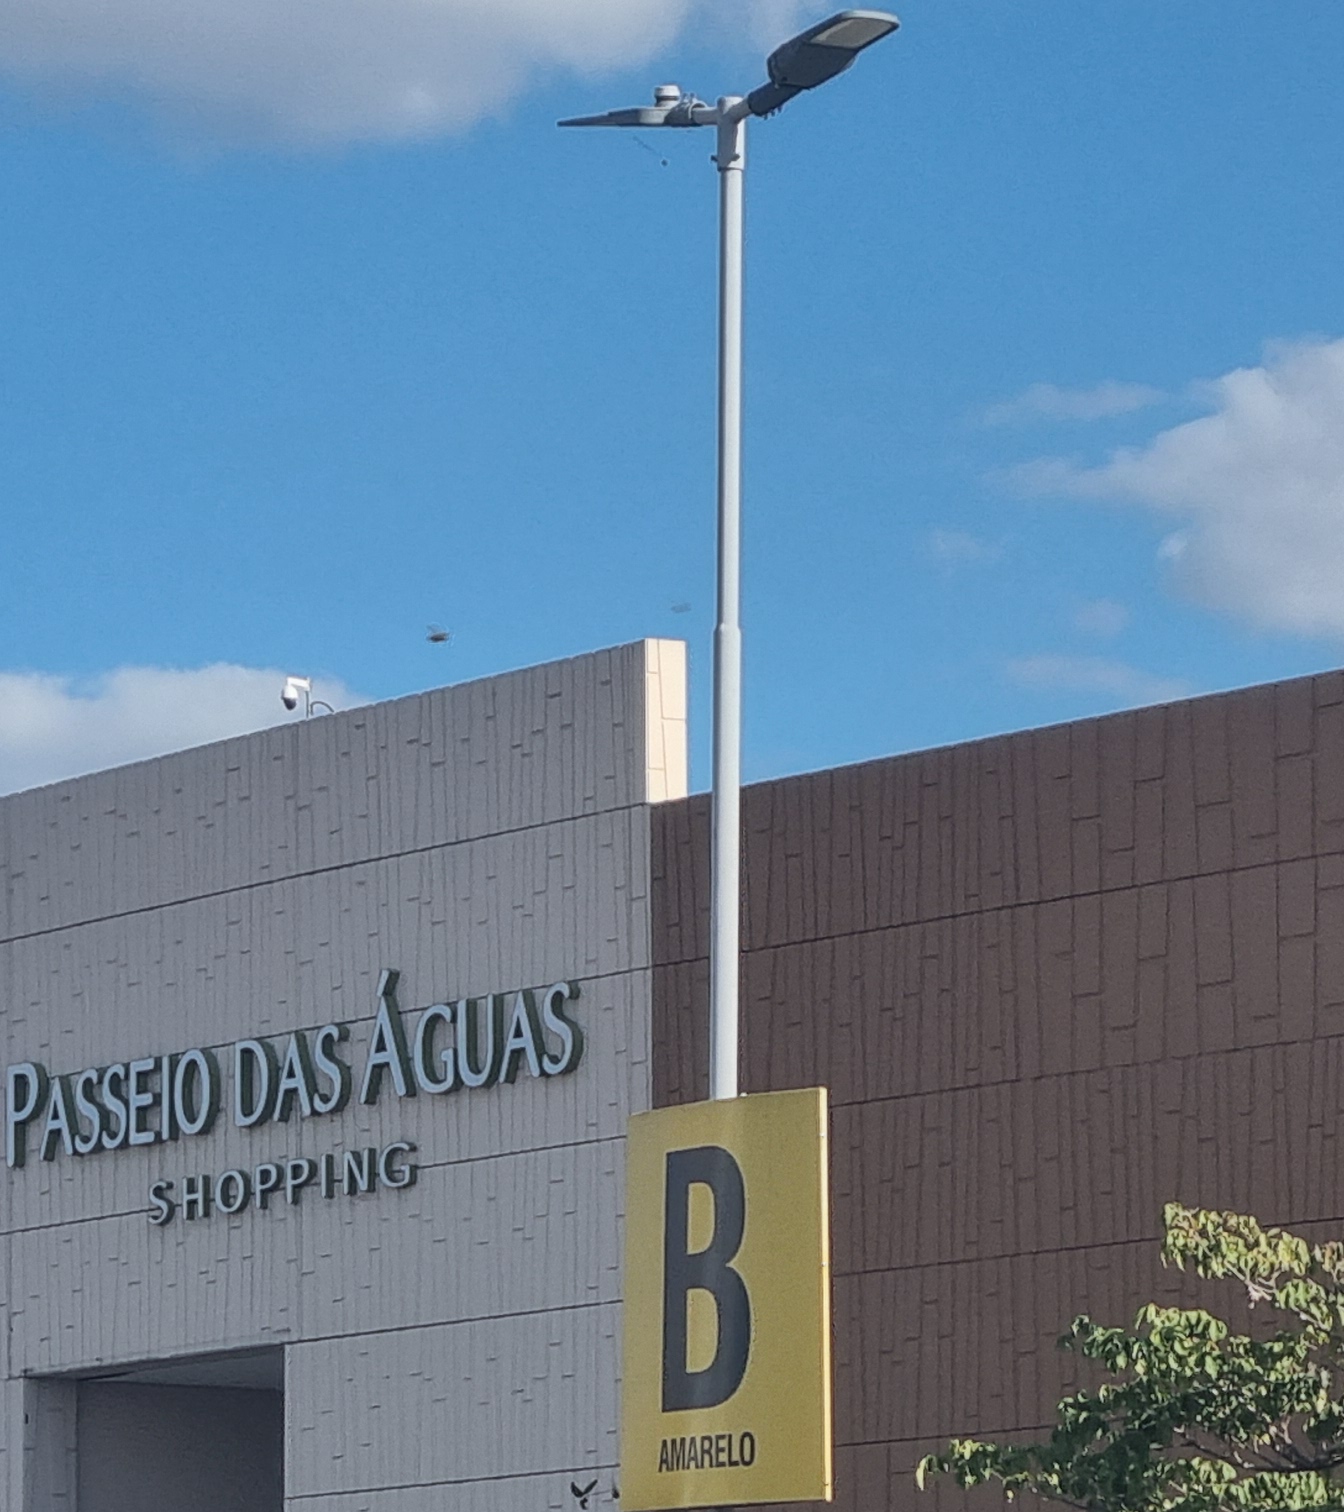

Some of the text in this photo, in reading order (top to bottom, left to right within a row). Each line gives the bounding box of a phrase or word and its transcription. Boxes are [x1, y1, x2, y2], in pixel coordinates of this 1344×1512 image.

[6, 968, 583, 1168] PASSEIO DAS ÁGUAS
[149, 1141, 417, 1226] SHOPPING
[662, 1145, 752, 1413] B
[658, 1431, 756, 1473] AMARELO
